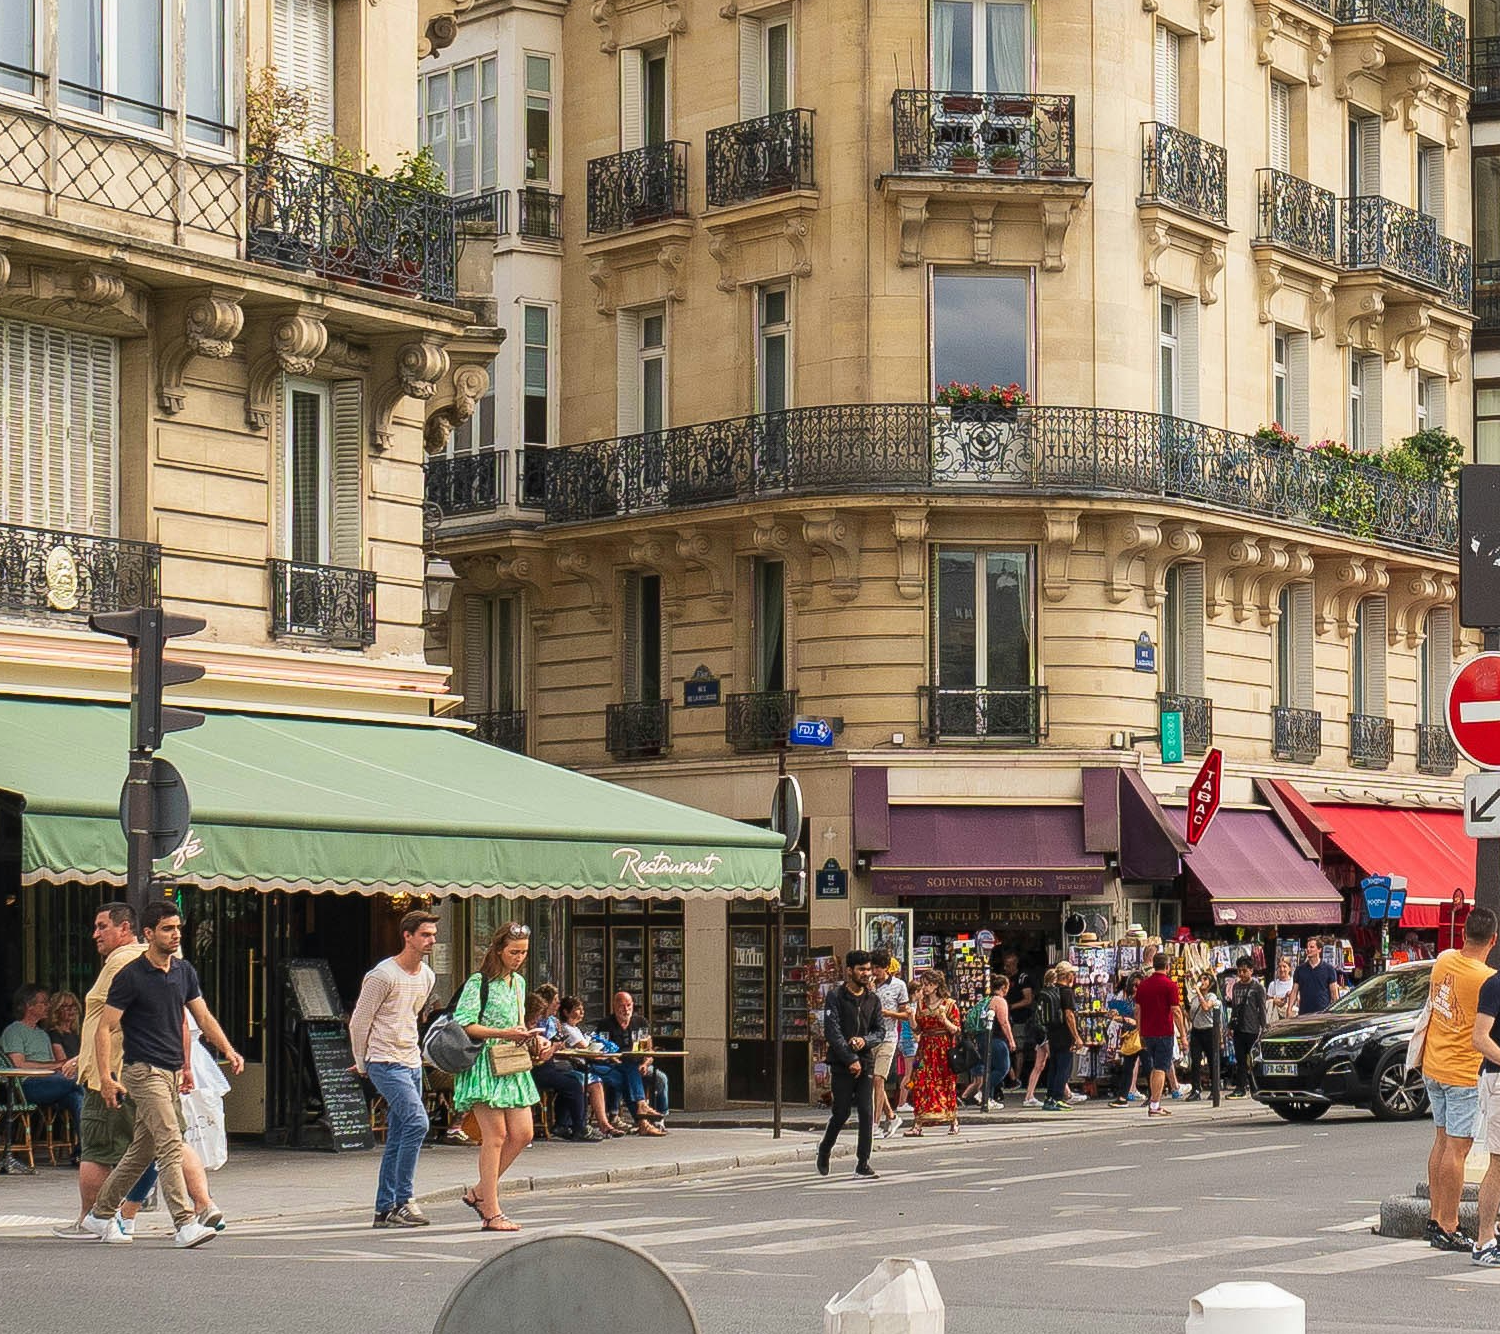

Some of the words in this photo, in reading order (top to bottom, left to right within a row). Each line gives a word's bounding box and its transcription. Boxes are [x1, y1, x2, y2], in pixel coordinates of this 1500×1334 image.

[798, 725, 815, 735] FDJ
[1193, 769, 1216, 825] TABAC
[612, 847, 723, 885] Restaurant
[926, 877, 992, 888] SOUVENIRS
[994, 877, 1010, 888] OF
[1011, 876, 1045, 888] PARIS
[926, 911, 980, 922] ARTICLES
[990, 911, 1004, 921] DE
[1009, 911, 1042, 922] PARIS
